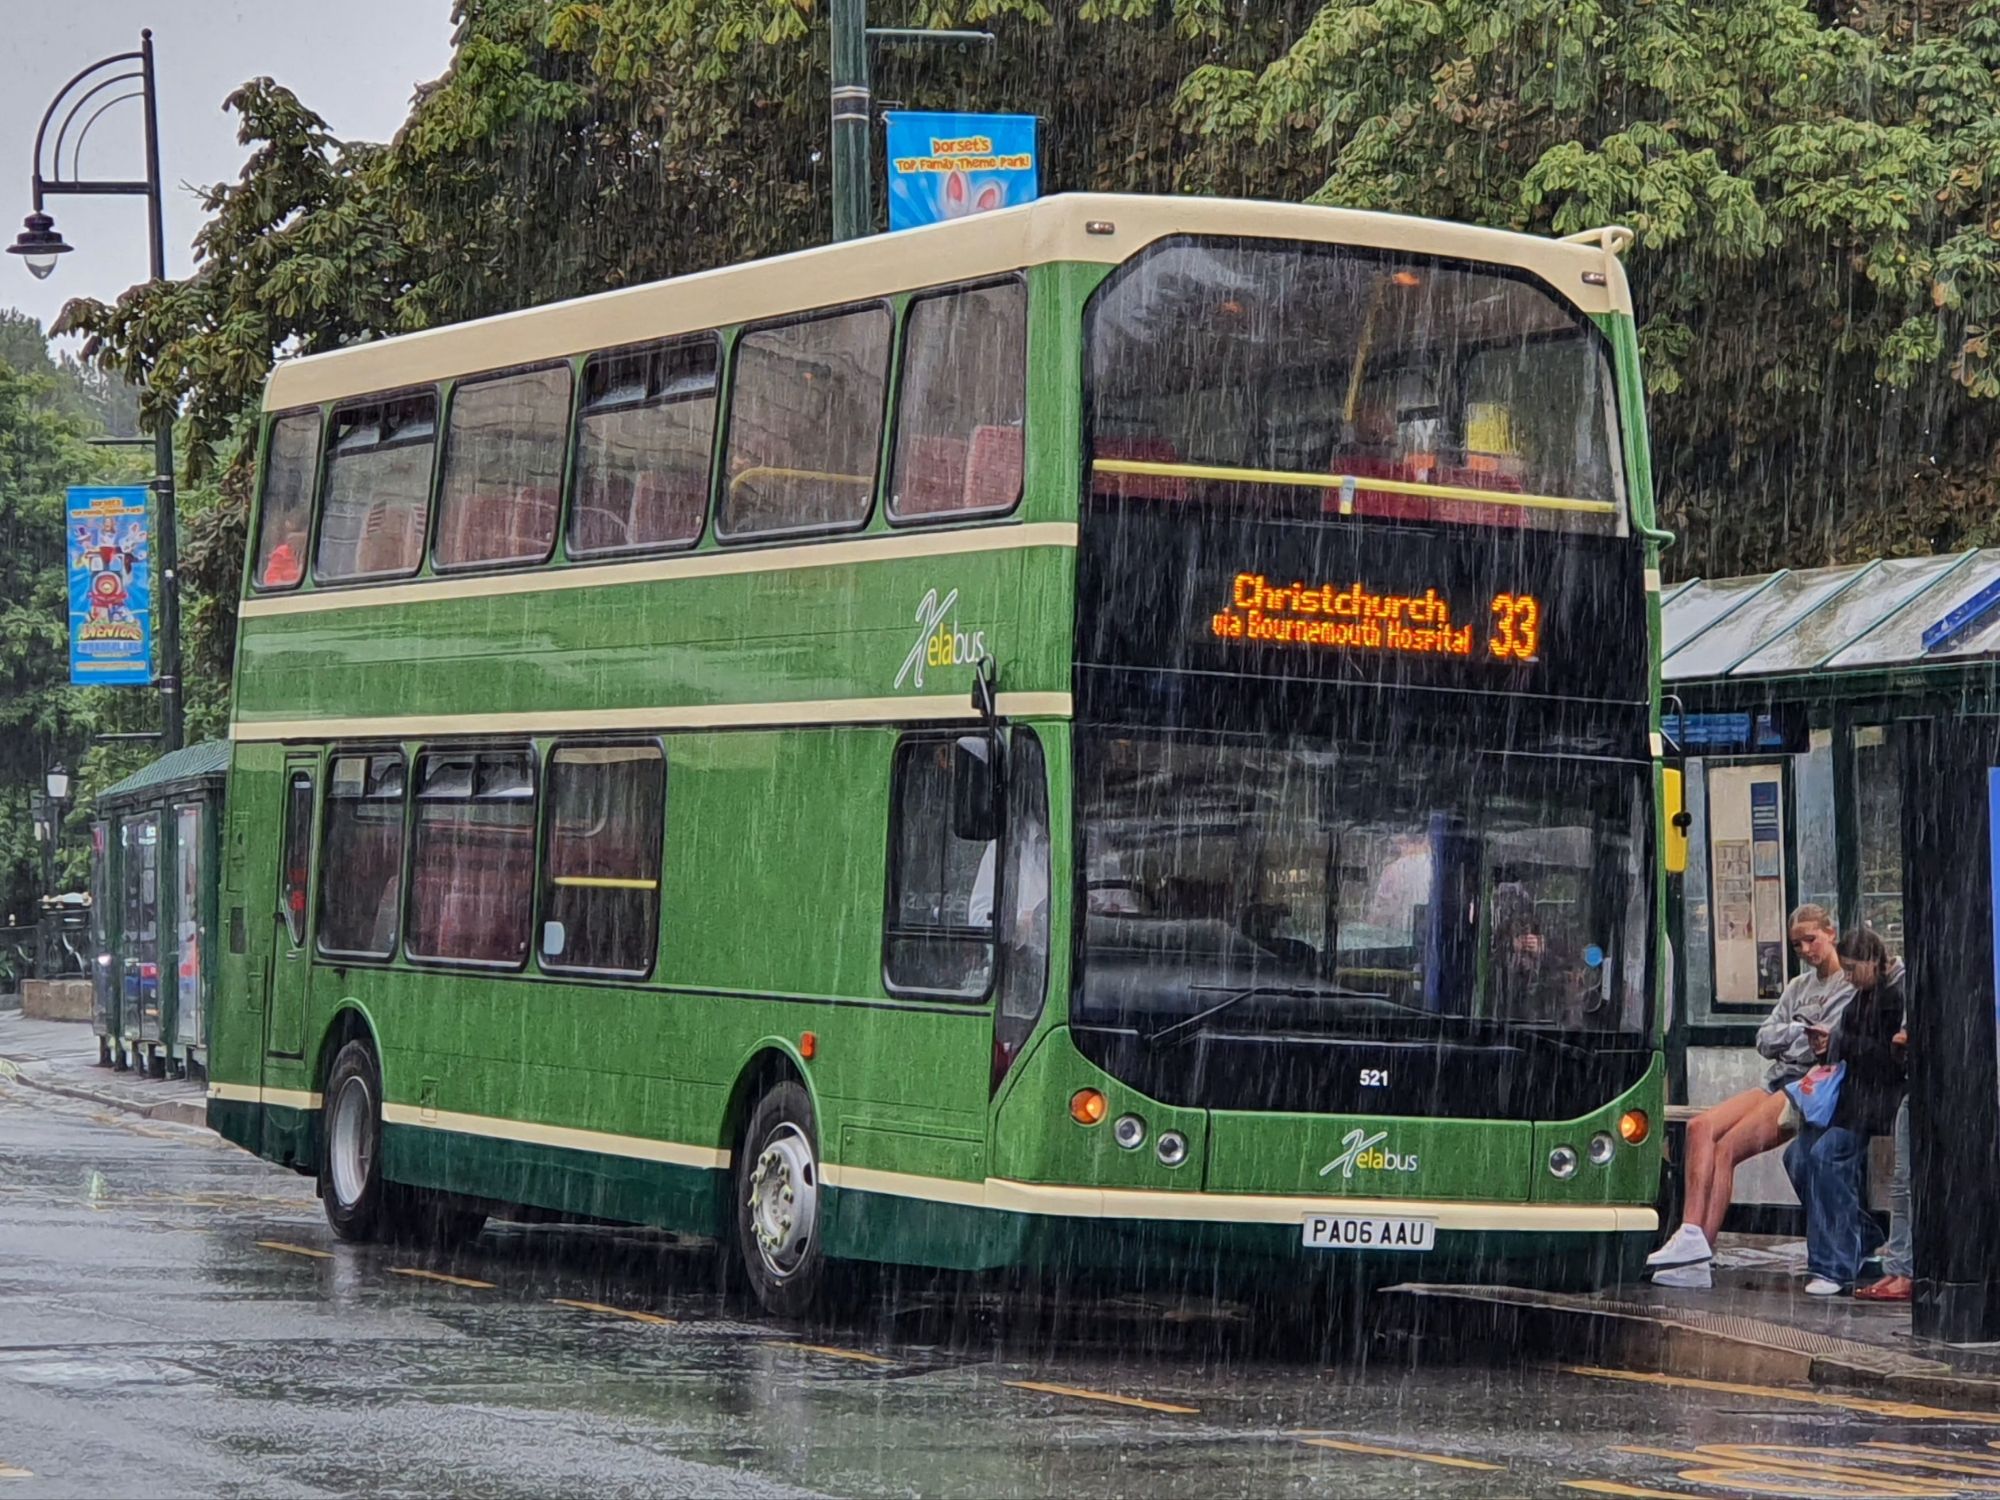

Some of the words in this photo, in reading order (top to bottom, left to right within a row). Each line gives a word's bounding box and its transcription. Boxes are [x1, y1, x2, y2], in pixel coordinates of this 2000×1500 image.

[920, 158, 955, 171] Family
[957, 157, 996, 170] Theme
[932, 137, 990, 154] Dorset's
[1212, 607, 1243, 638] via
[1247, 609, 1381, 647] Bournemouth
[1387, 620, 1472, 655] Hospital
[1234, 572, 1447, 622] Christchurch
[1490, 594, 1537, 658] 33
[894, 588, 985, 690] Xelabus
[1359, 1069, 1389, 1087] 521
[1319, 1128, 1419, 1178] Xelabus
[1313, 1219, 1372, 1244] PA06
[1380, 1222, 1424, 1245] AAU
